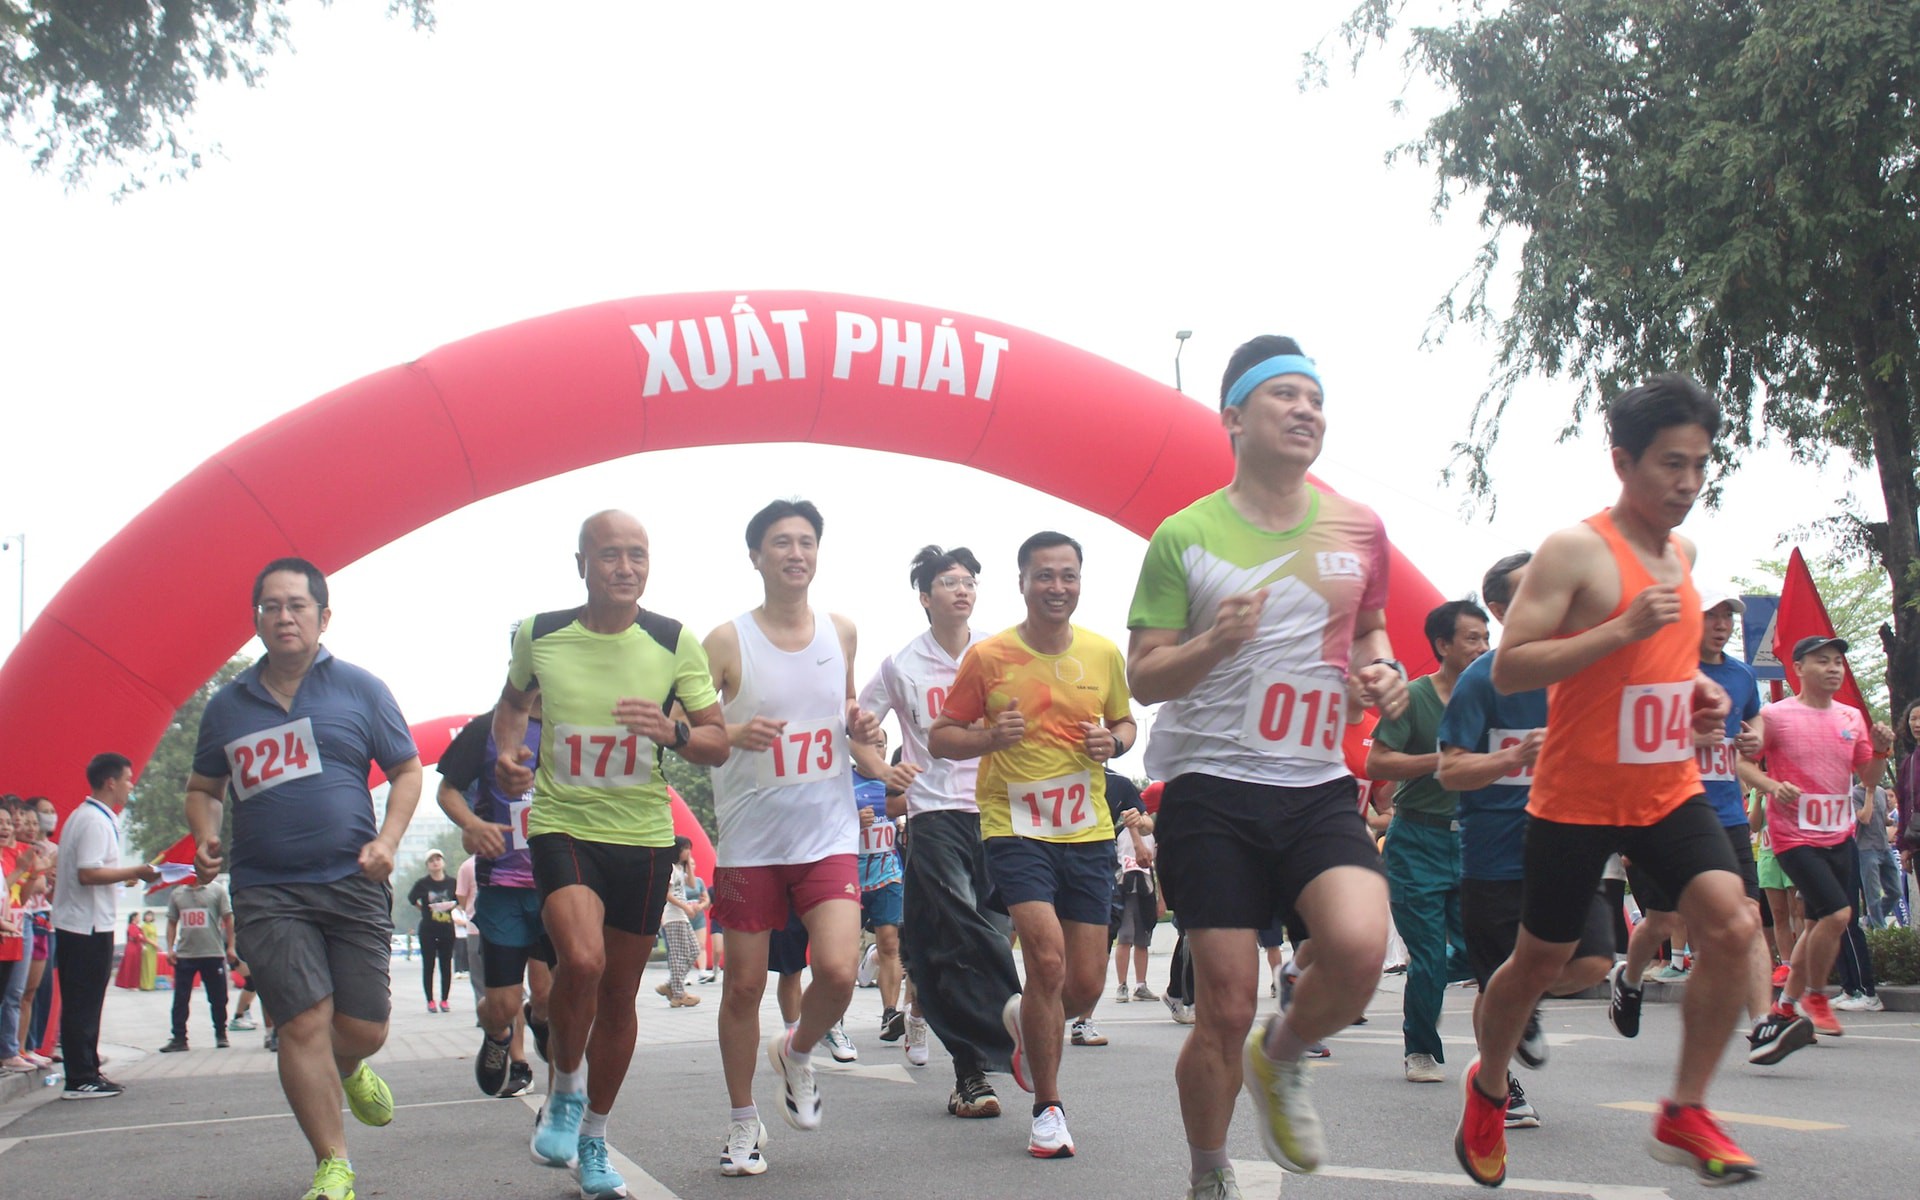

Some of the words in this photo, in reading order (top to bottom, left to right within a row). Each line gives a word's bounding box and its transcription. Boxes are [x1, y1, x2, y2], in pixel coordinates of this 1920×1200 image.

[630, 295, 809, 397] XUẤT
[832, 311, 1009, 400] PHÁT
[1258, 682, 1342, 750] 015
[1634, 693, 1694, 753] 04
[234, 731, 309, 790] 224
[565, 734, 637, 777] 171
[771, 728, 833, 778] 173
[1022, 783, 1086, 827] 172
[1806, 799, 1844, 826] 017
[861, 825, 894, 850] 170
[182, 911, 206, 927] 108
